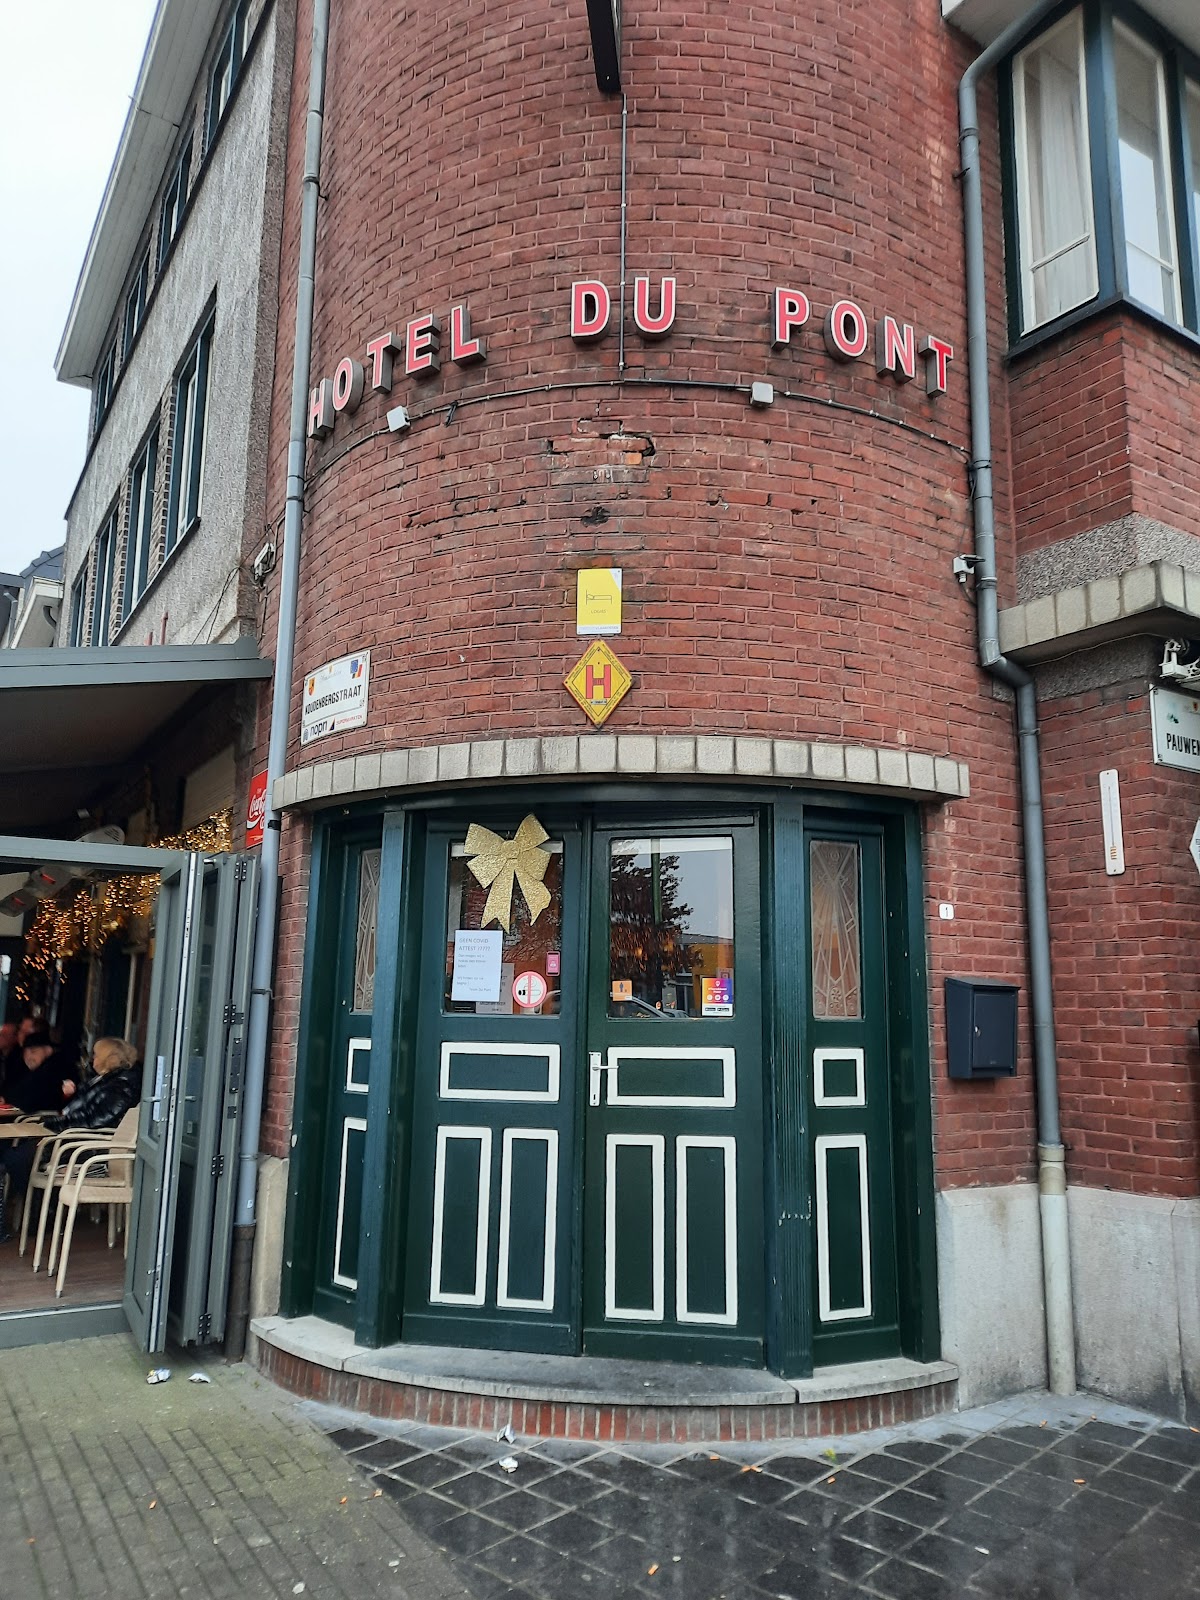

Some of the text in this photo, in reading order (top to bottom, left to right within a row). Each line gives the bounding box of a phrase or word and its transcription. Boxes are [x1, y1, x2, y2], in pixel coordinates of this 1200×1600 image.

[308, 276, 954, 440] HOTEL DU PONT
[585, 664, 611, 699] H
[305, 685, 362, 715] KOUDENBERGSTRAAT
